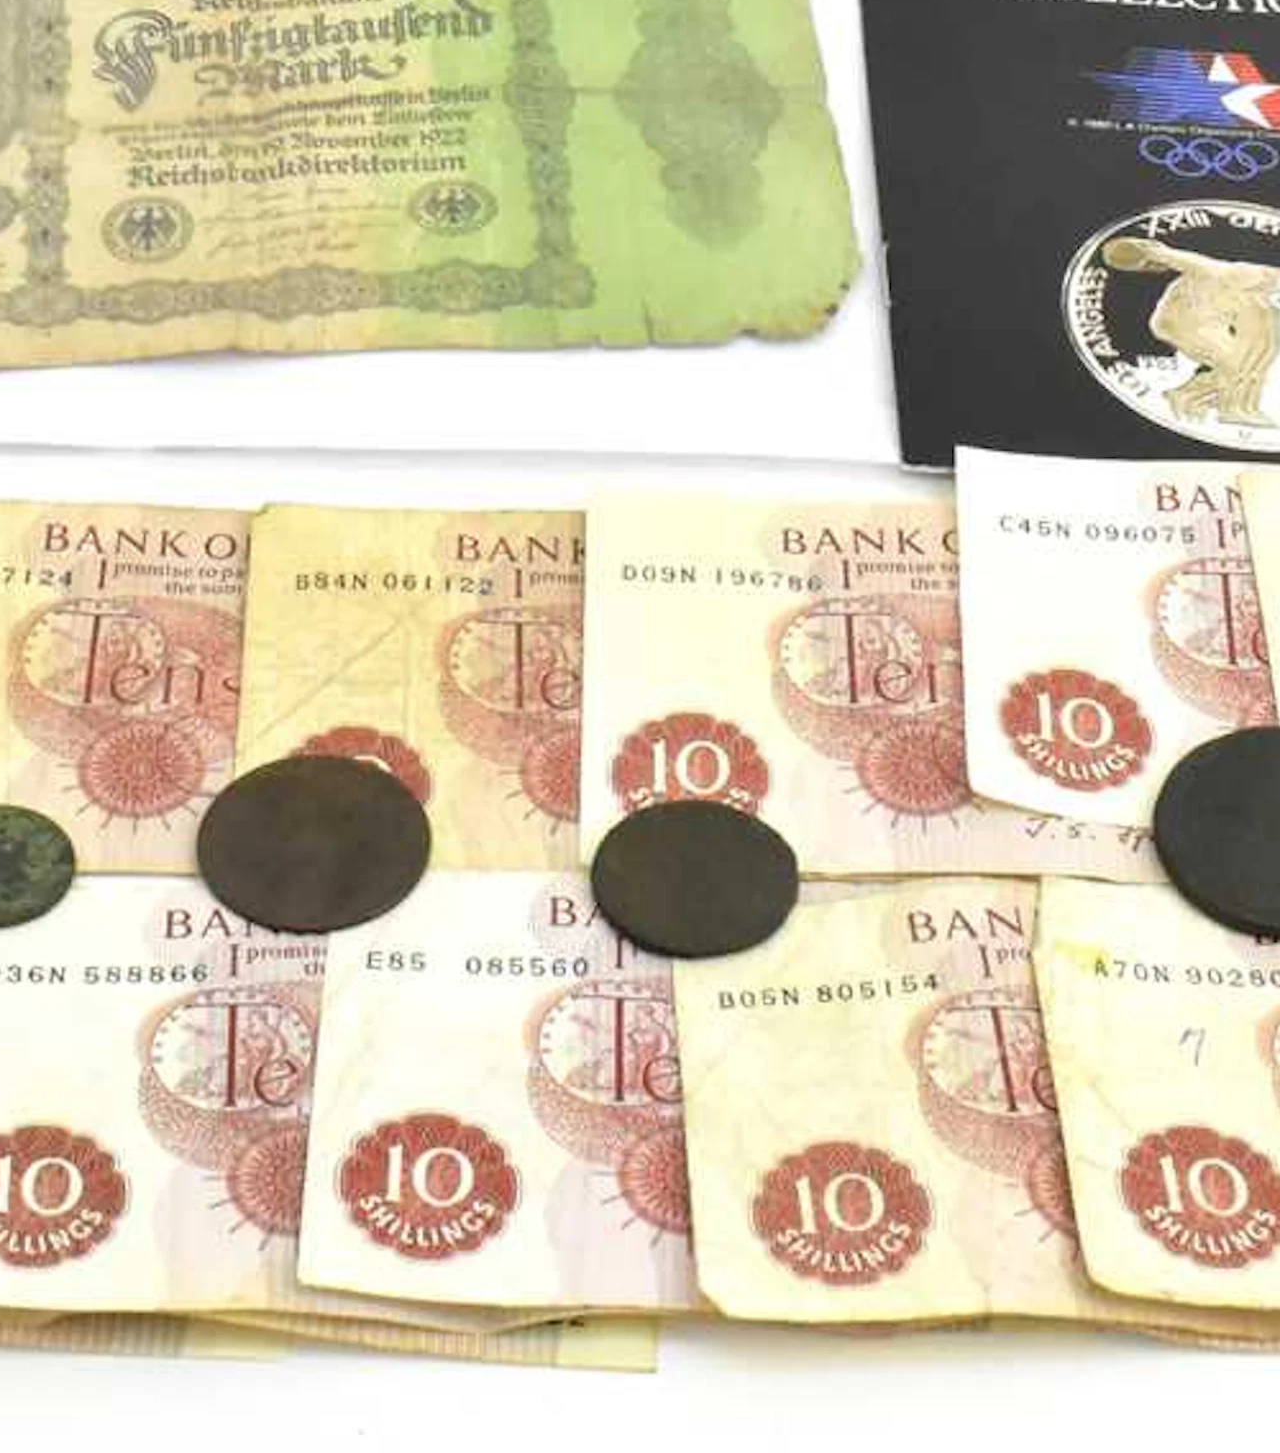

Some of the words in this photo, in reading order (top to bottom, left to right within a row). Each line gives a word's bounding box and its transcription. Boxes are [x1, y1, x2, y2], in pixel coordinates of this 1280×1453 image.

[1071, 264, 1120, 359] ANGELES
[43, 522, 187, 556] BANK
[781, 527, 926, 556] BANK
[999, 514, 1074, 539] C45N
[1084, 523, 1197, 545] 096075
[111, 561, 192, 580] promise
[295, 572, 368, 592] B84N
[382, 574, 495, 597] 061122
[621, 564, 697, 584] D09N
[715, 567, 823, 593] 196786
[53, 610, 204, 707] Ten
[1035, 692, 1115, 749] 10
[651, 737, 732, 796] 10
[1019, 731, 1137, 782] SHILLINGS
[906, 905, 1023, 945] BAN
[83, 964, 211, 986] 588866
[365, 951, 428, 972] E85
[464, 956, 591, 978] 085560
[1094, 955, 1173, 984] A70N
[719, 987, 802, 1010] B05N
[816, 972, 940, 1004] 805154
[384, 1143, 475, 1208] 10
[1158, 1152, 1251, 1217] 10
[358, 1193, 497, 1248] SHILLINGS
[793, 1172, 886, 1236] 10
[774, 1218, 913, 1275] SHILLINGS
[1144, 1203, 1279, 1256] SHILLINGS
